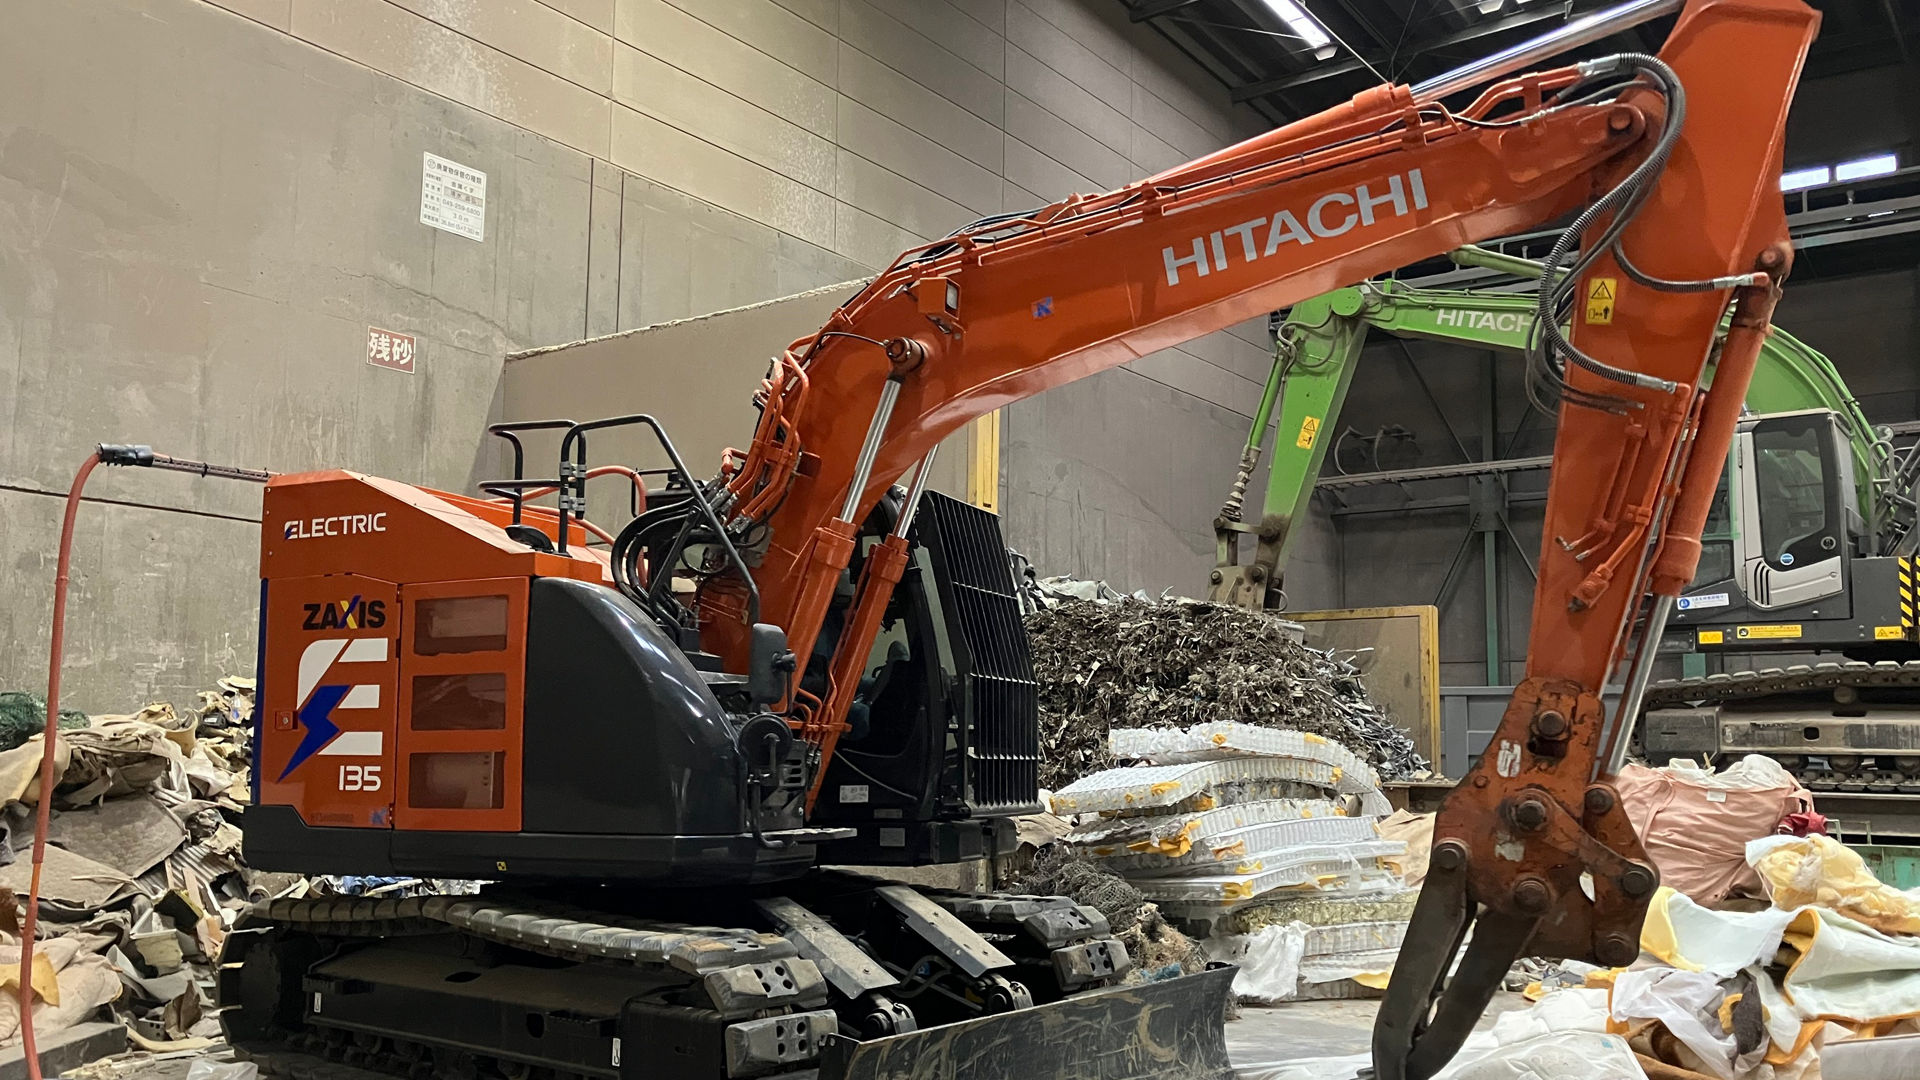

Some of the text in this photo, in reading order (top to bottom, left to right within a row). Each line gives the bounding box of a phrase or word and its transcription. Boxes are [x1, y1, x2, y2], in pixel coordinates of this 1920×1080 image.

[1161, 168, 1429, 287] HITACHI
[1436, 308, 1531, 333] HITACH
[369, 332, 413, 365] 残砂
[284, 512, 387, 540] ELECTRIC
[302, 594, 387, 631] ZAXIS
[338, 765, 382, 792] 135
